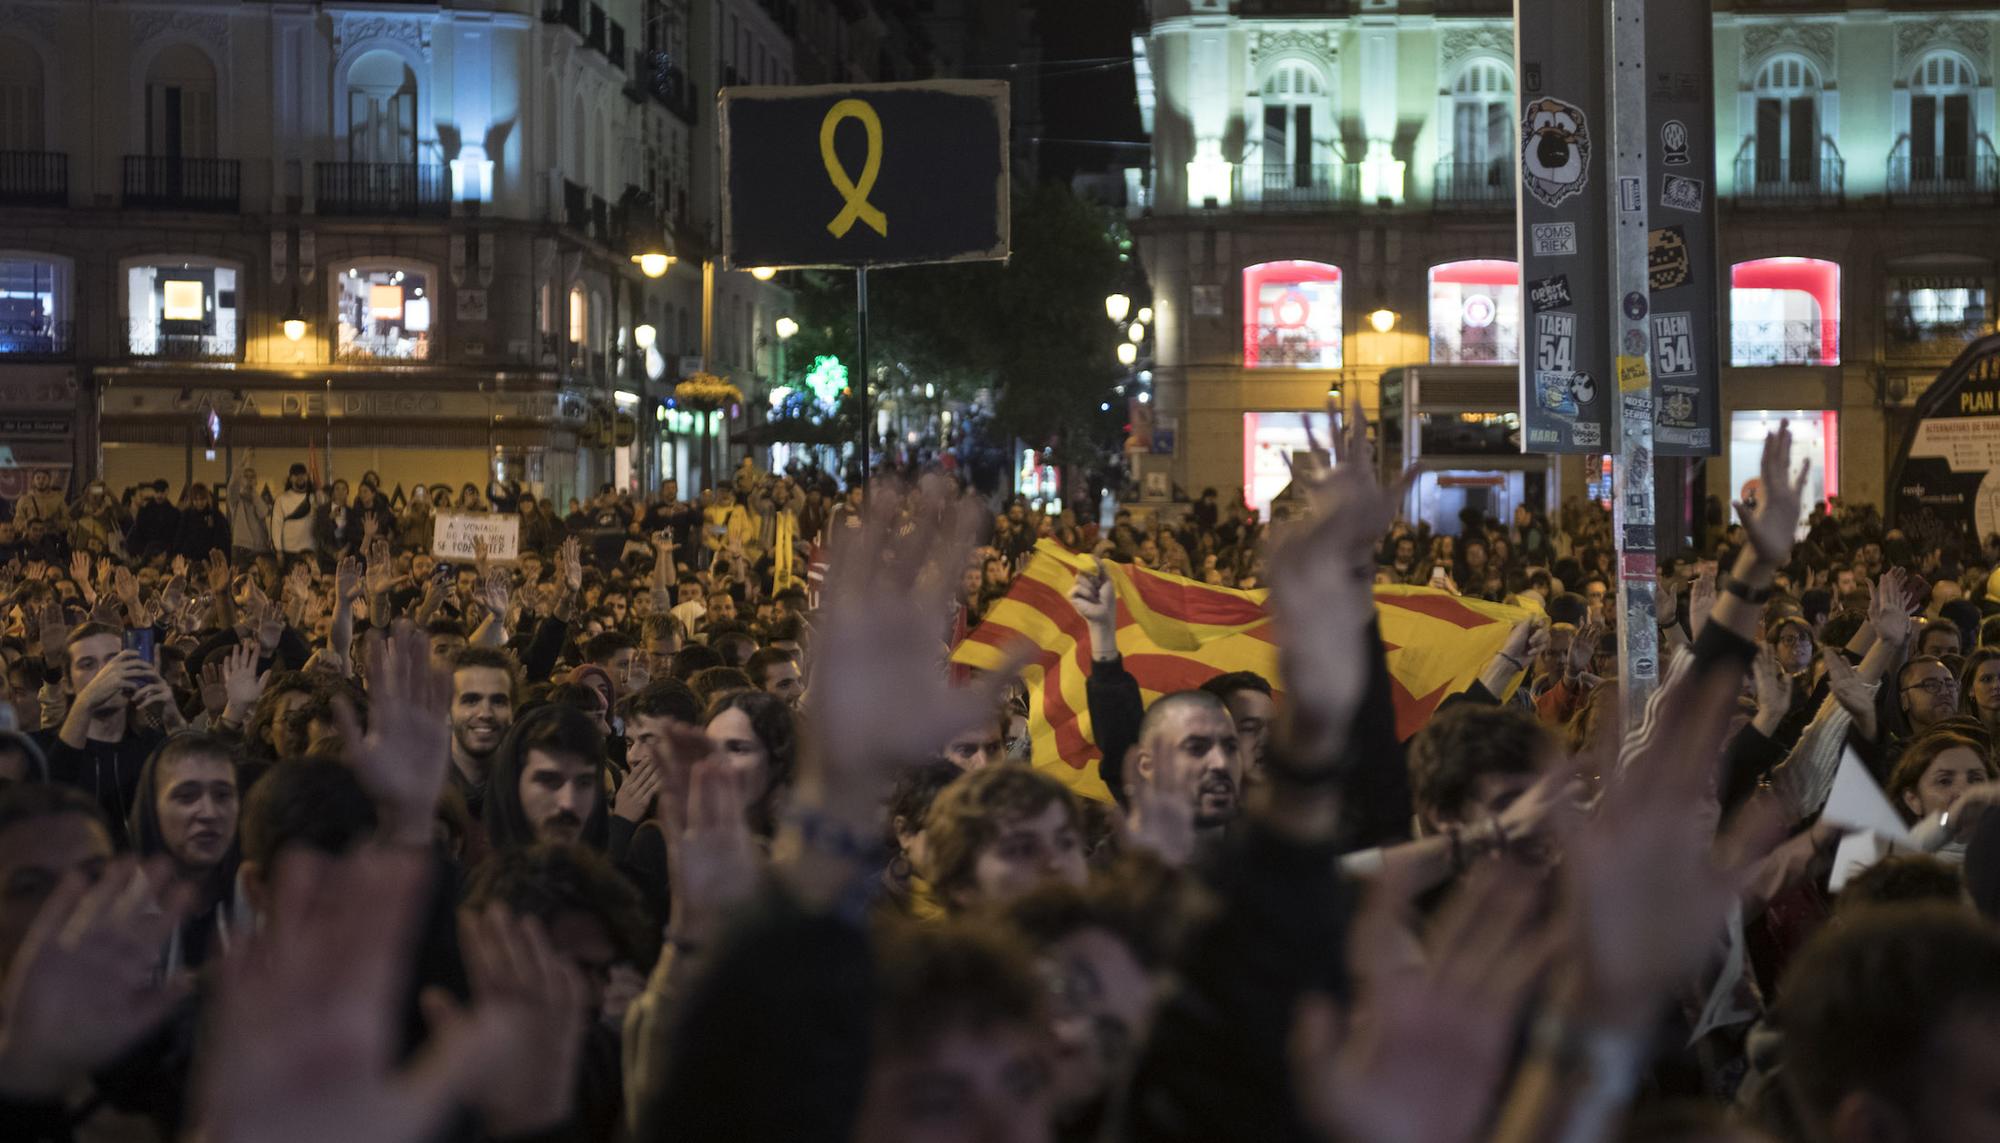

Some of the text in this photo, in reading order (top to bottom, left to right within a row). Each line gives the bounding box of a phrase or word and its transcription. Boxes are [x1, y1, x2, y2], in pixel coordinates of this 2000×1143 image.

[1535, 226, 1572, 239] COMS
[1540, 239, 1568, 251] RIEK
[1540, 315, 1572, 336] TAEM
[1655, 316, 1689, 336] TAEM
[1539, 335, 1571, 372] 54
[1658, 335, 1692, 373] 54
[174, 392, 440, 414] CASA DE DIEGO
[1961, 391, 1994, 412] PLAN
